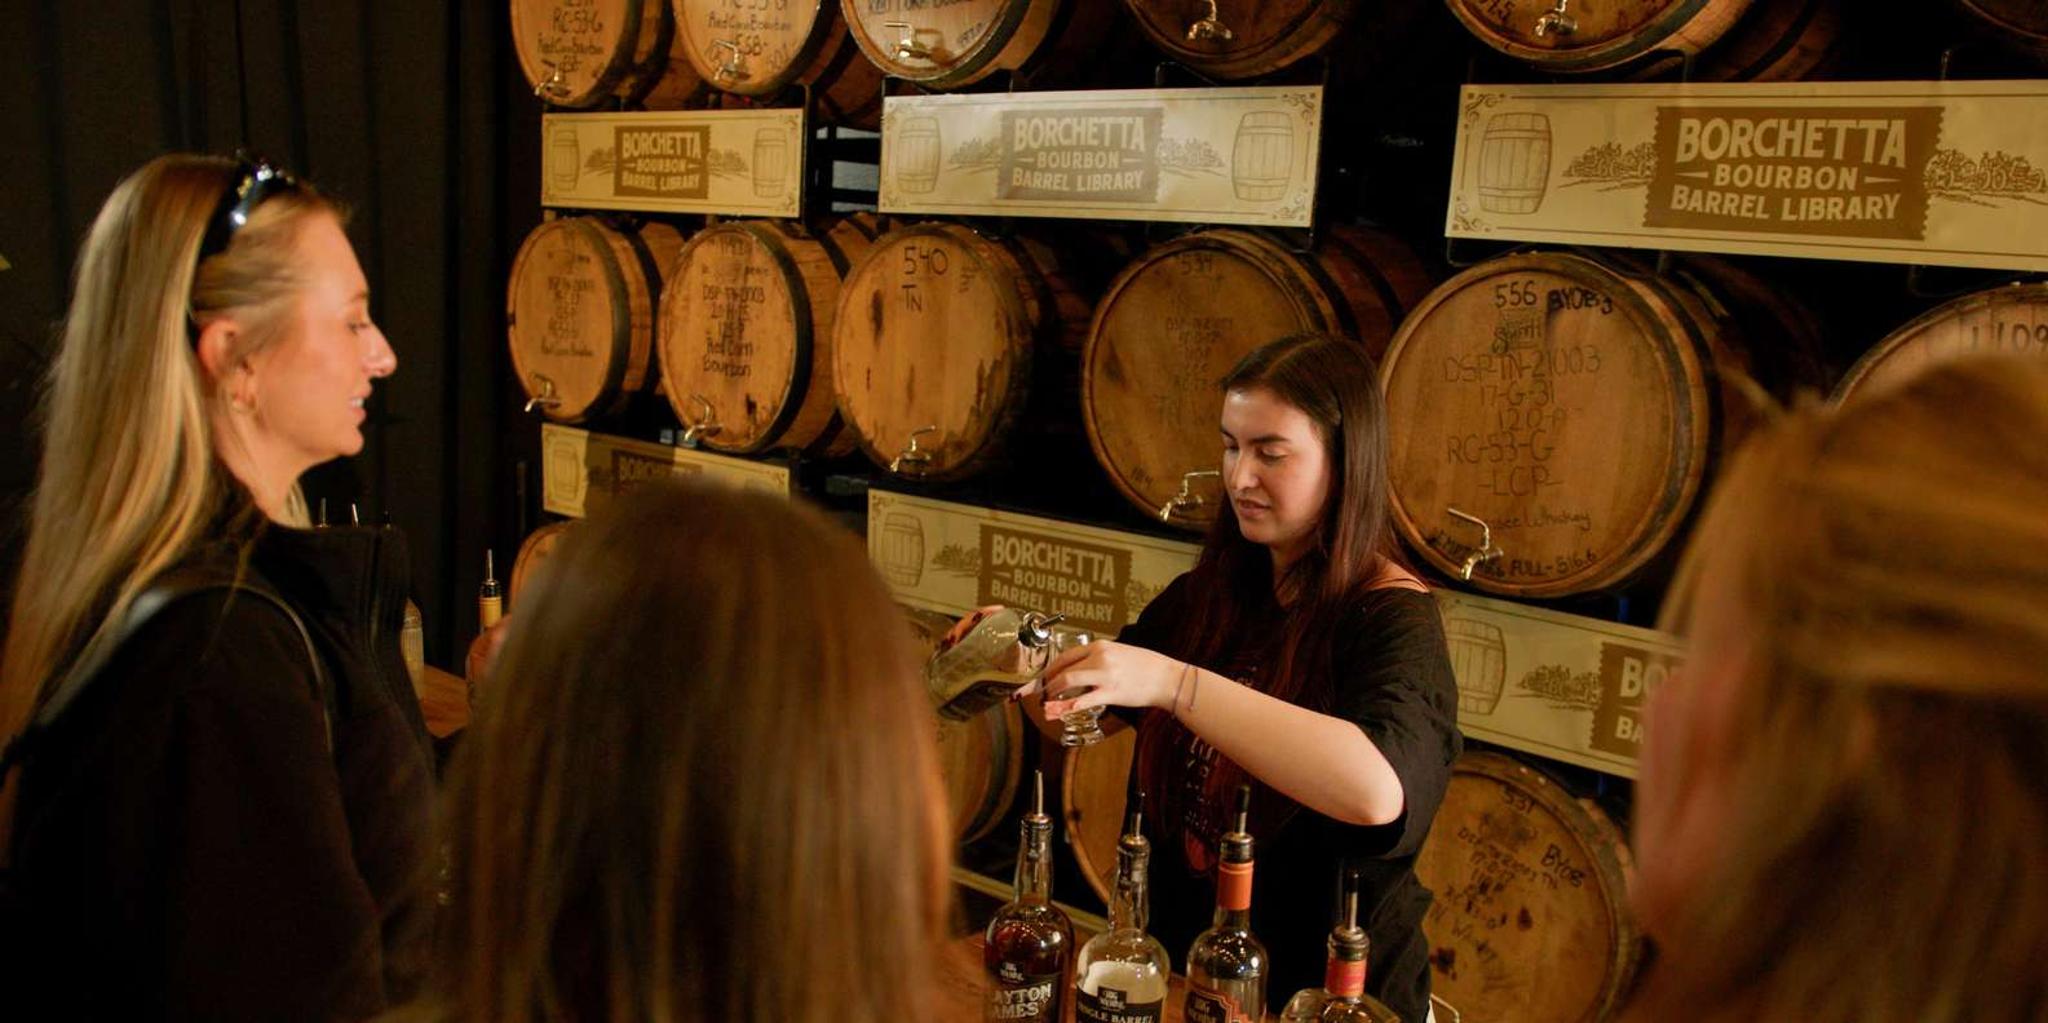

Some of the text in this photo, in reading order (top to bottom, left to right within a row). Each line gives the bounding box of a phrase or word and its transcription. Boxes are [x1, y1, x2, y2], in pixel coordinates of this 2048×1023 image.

[622, 130, 700, 158] BORCHETTA
[1013, 116, 1145, 153] BORCHETTA
[1676, 119, 1906, 168] BORCHETTA
[637, 158, 686, 173] BOURBON
[1037, 151, 1120, 169] BOURBON
[622, 170, 700, 192] BARREL LIBRARY
[1013, 168, 1144, 192] BARREL LIBRARY
[1714, 165, 1857, 191] BOURBON
[1671, 185, 1901, 221] BARREL LIBRARY
[903, 245, 949, 275] 540
[901, 284, 922, 313] TN
[1495, 280, 1538, 308] 556
[991, 533, 1116, 588] BORCHETTA
[1013, 568, 1091, 600] BOURBON
[991, 582, 1114, 624] BARREL LIBRARY
[993, 984, 1052, 1004] AYTON
[993, 1001, 1039, 1019] AMES
